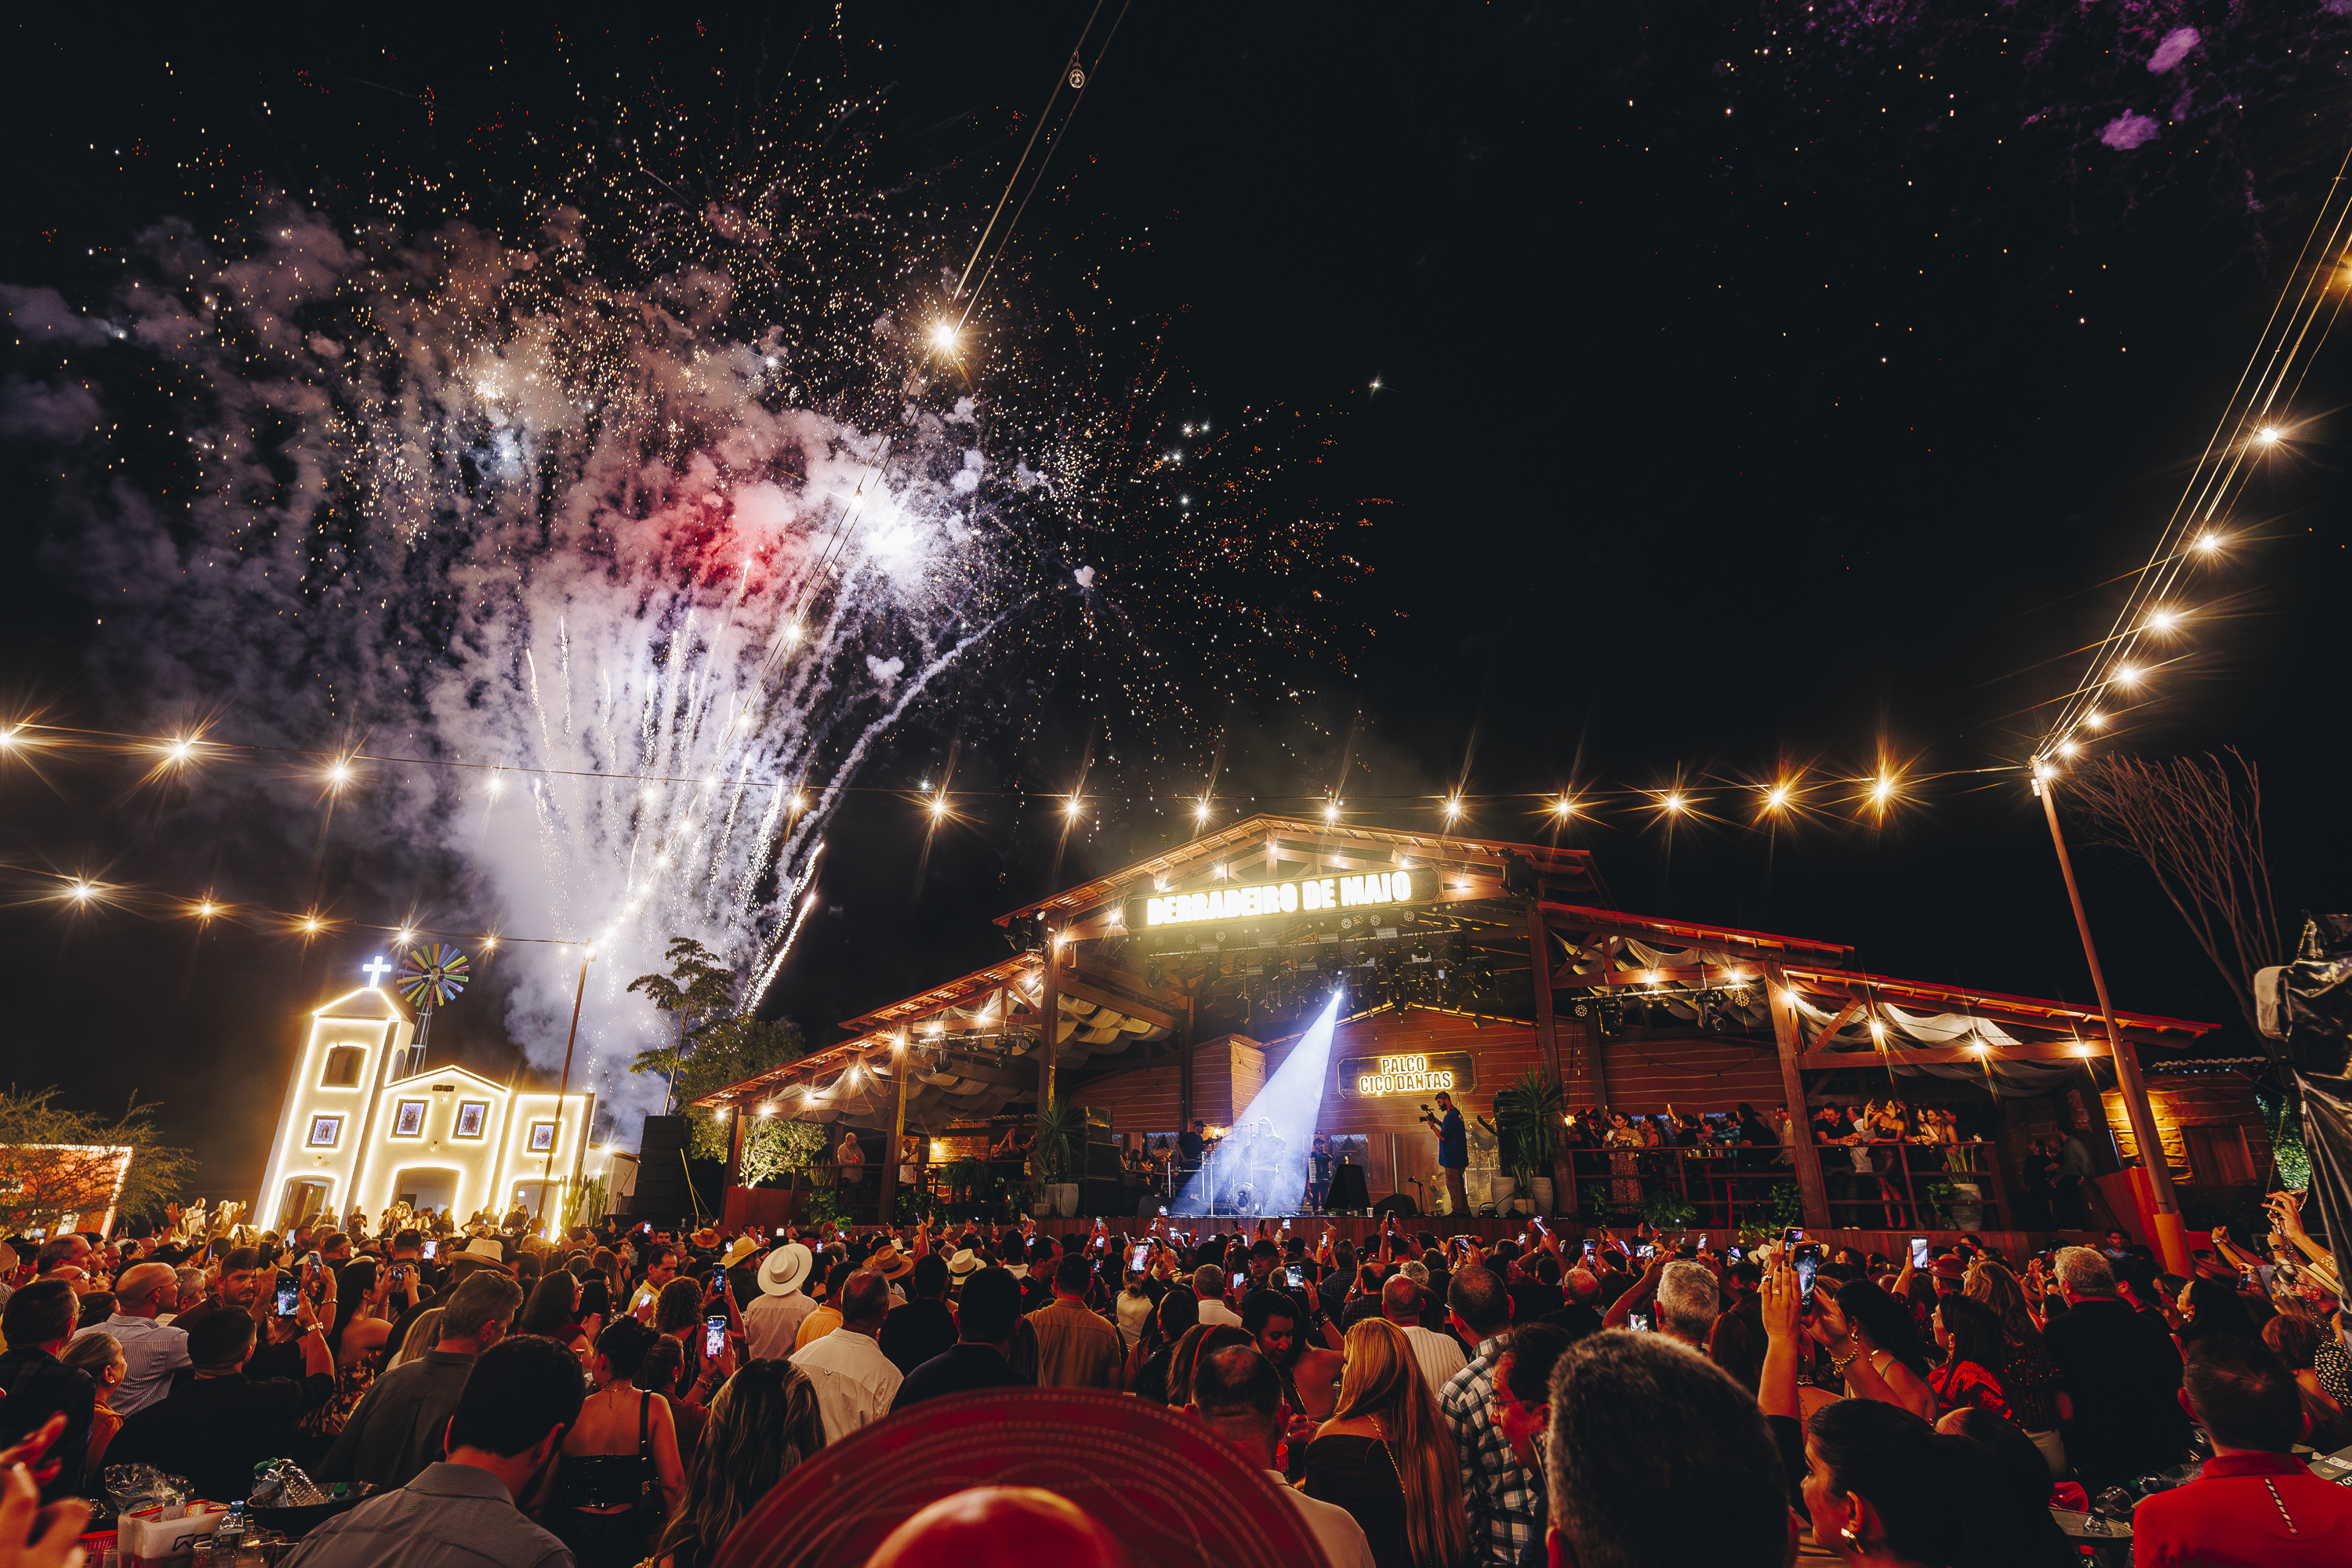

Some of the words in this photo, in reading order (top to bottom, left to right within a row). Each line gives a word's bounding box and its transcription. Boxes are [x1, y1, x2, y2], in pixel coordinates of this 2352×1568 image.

[1147, 883, 1298, 925] DERRADEIRO
[1301, 879, 1336, 910] DE
[1340, 870, 1412, 906] MAIO
[1381, 1055, 1426, 1075] PALCO
[1396, 1071, 1453, 1091] DANTAS
